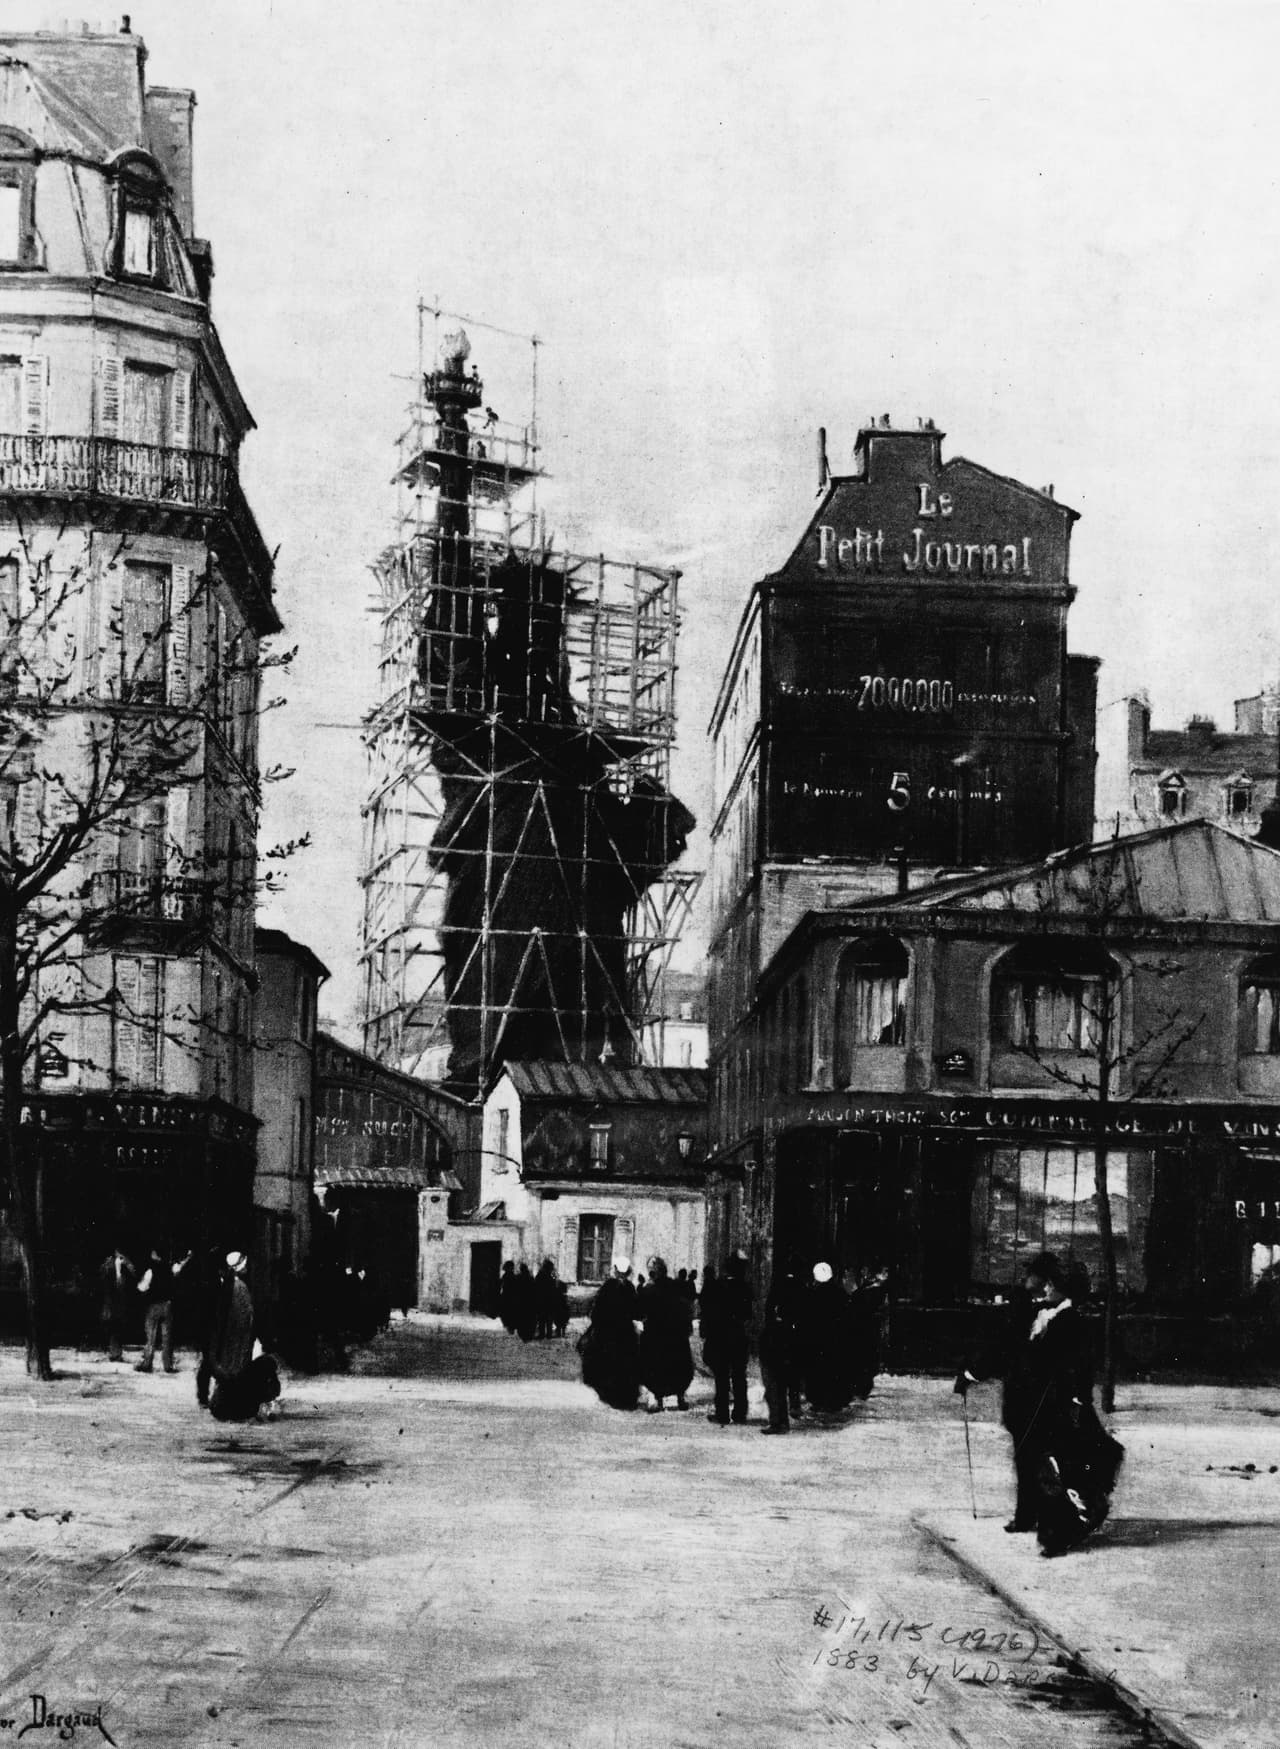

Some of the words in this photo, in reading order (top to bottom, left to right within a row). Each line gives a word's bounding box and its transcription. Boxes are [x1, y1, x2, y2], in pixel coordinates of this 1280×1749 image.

[918, 483, 953, 516] Le
[817, 526, 885, 569] Petit
[904, 528, 1032, 576] Journal
[887, 771, 911, 811] 5
[813, 1648, 879, 1672] 1883
[906, 1657, 939, 1694] by
